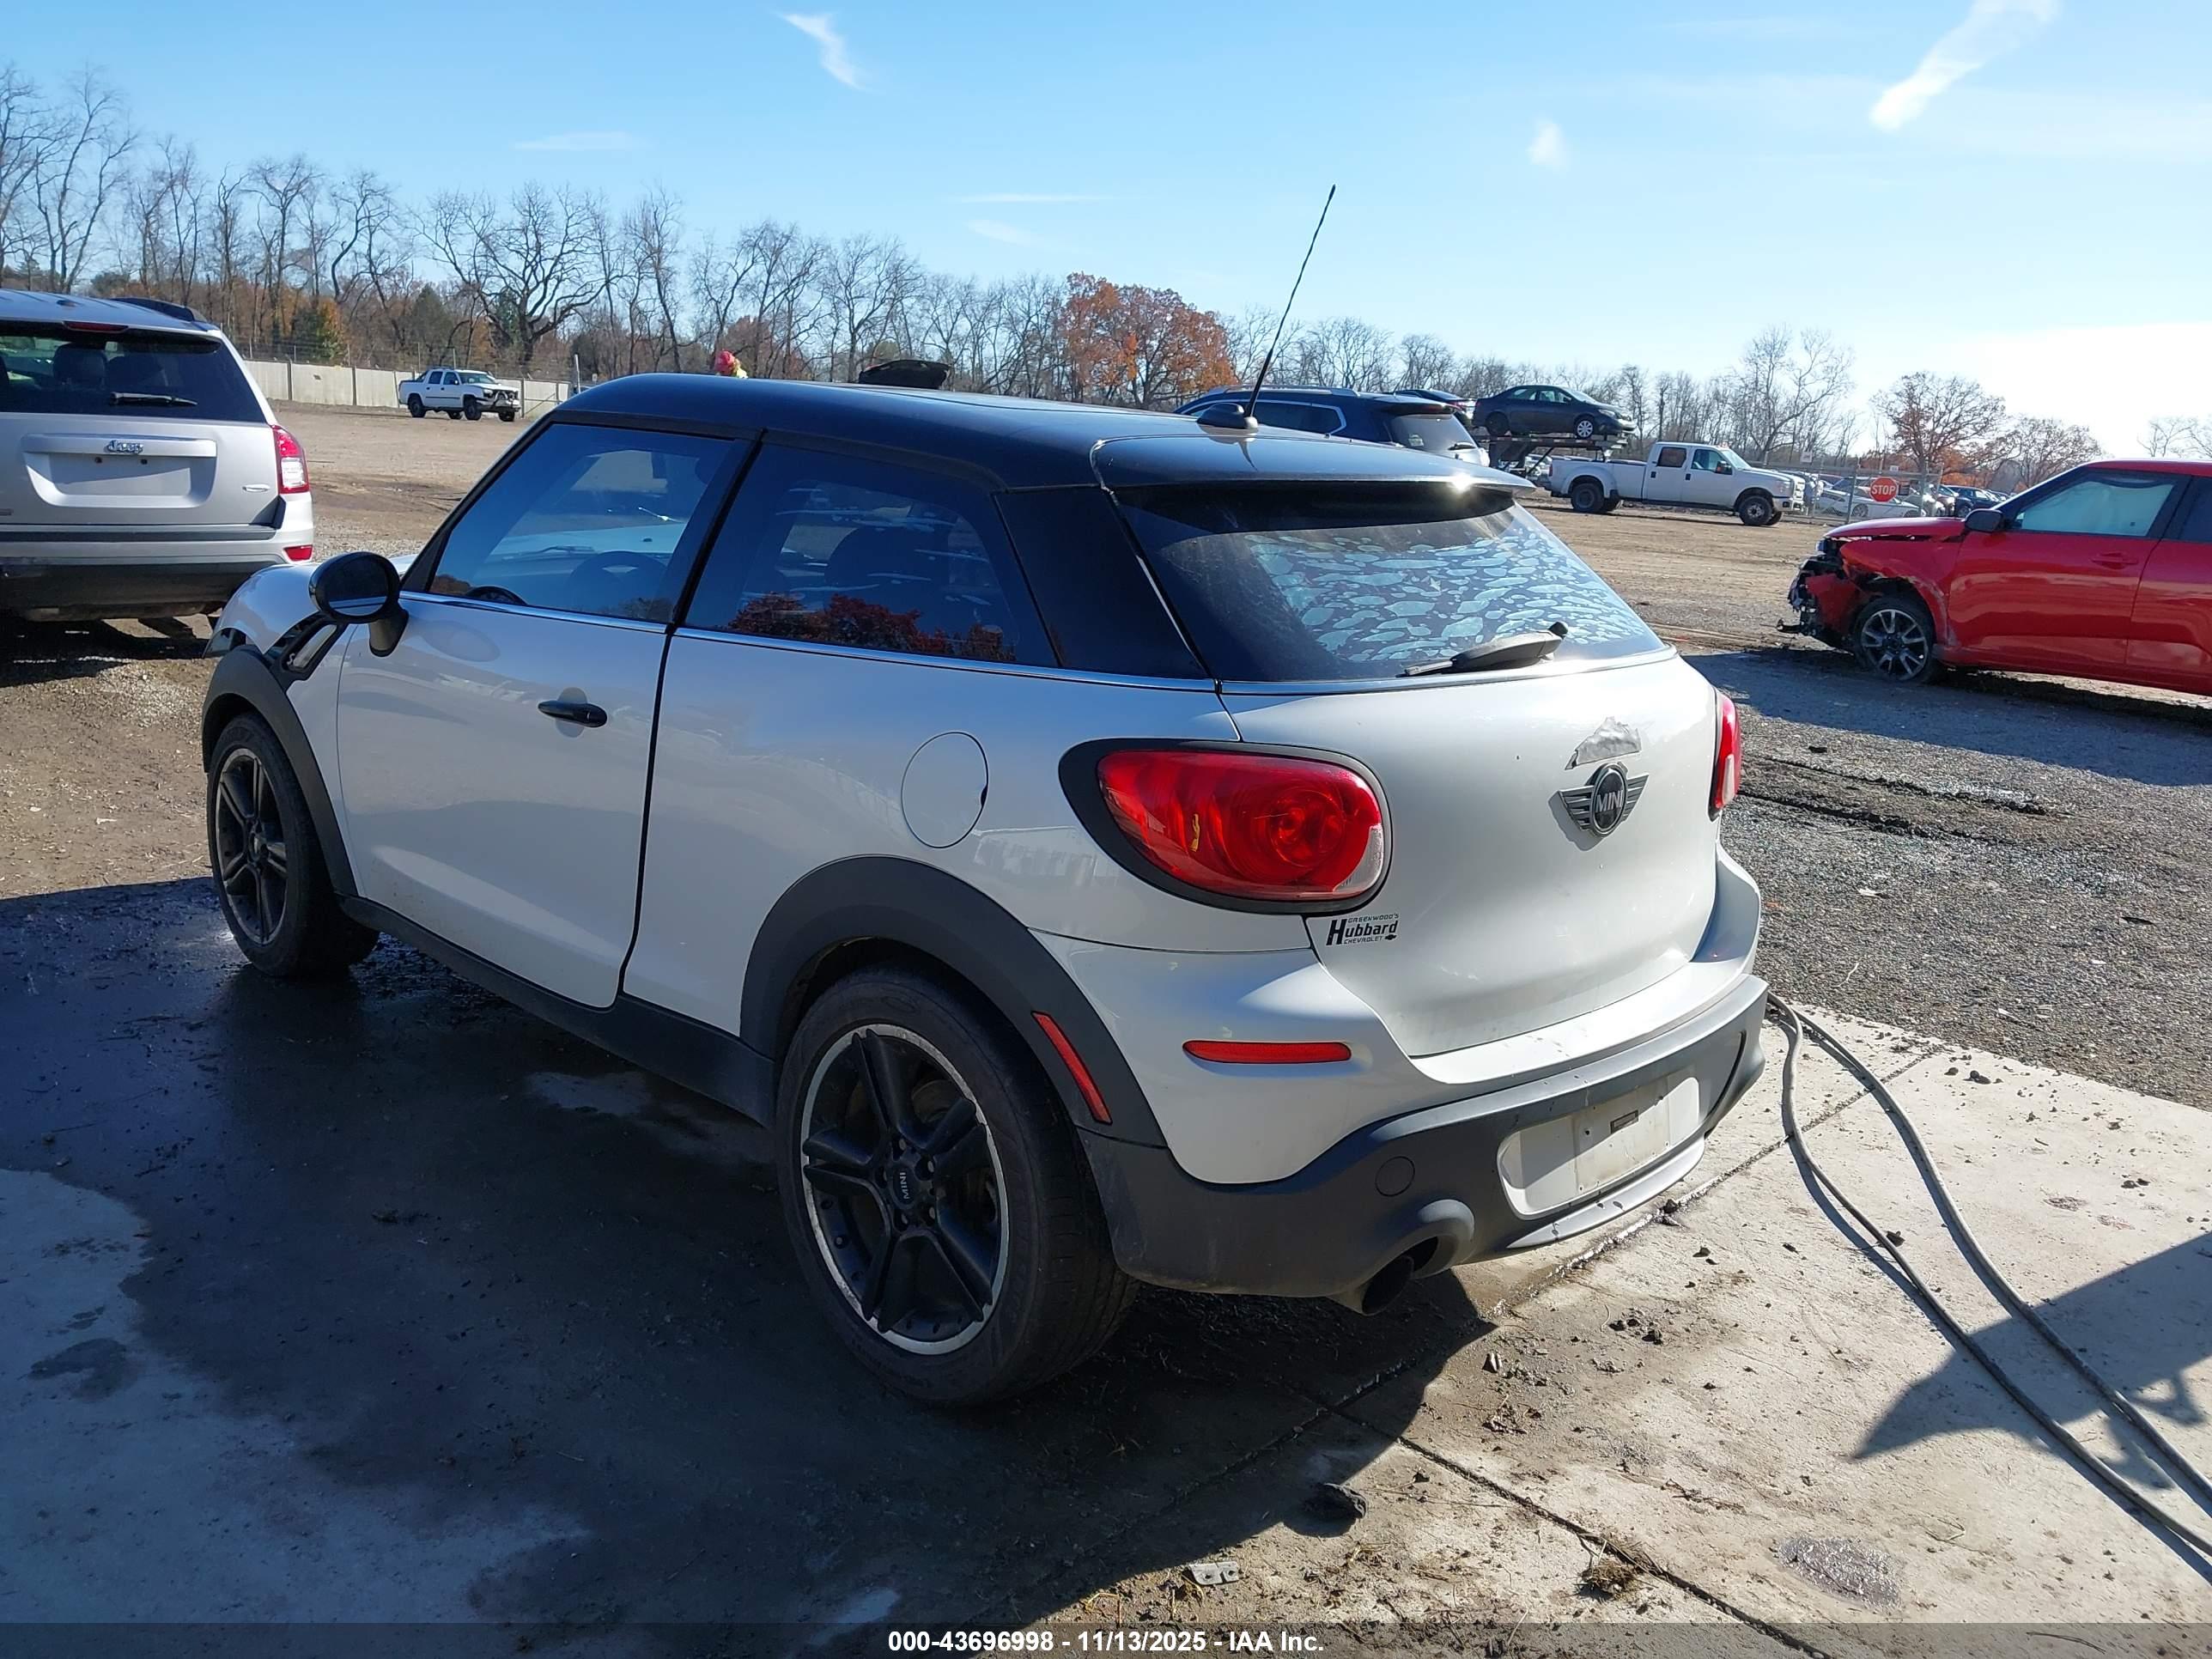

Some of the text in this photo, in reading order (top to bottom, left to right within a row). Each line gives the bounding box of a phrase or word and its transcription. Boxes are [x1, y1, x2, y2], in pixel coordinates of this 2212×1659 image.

[105, 439, 143, 454] Jeep
[1872, 484, 1896, 495] STOP
[1595, 790, 1623, 812] MINI
[1347, 913, 1400, 923] GREENWOOD'S
[1326, 919, 1399, 945] Hubbard
[1344, 935, 1382, 945] CHEVROLET
[899, 1172, 910, 1200] MINI
